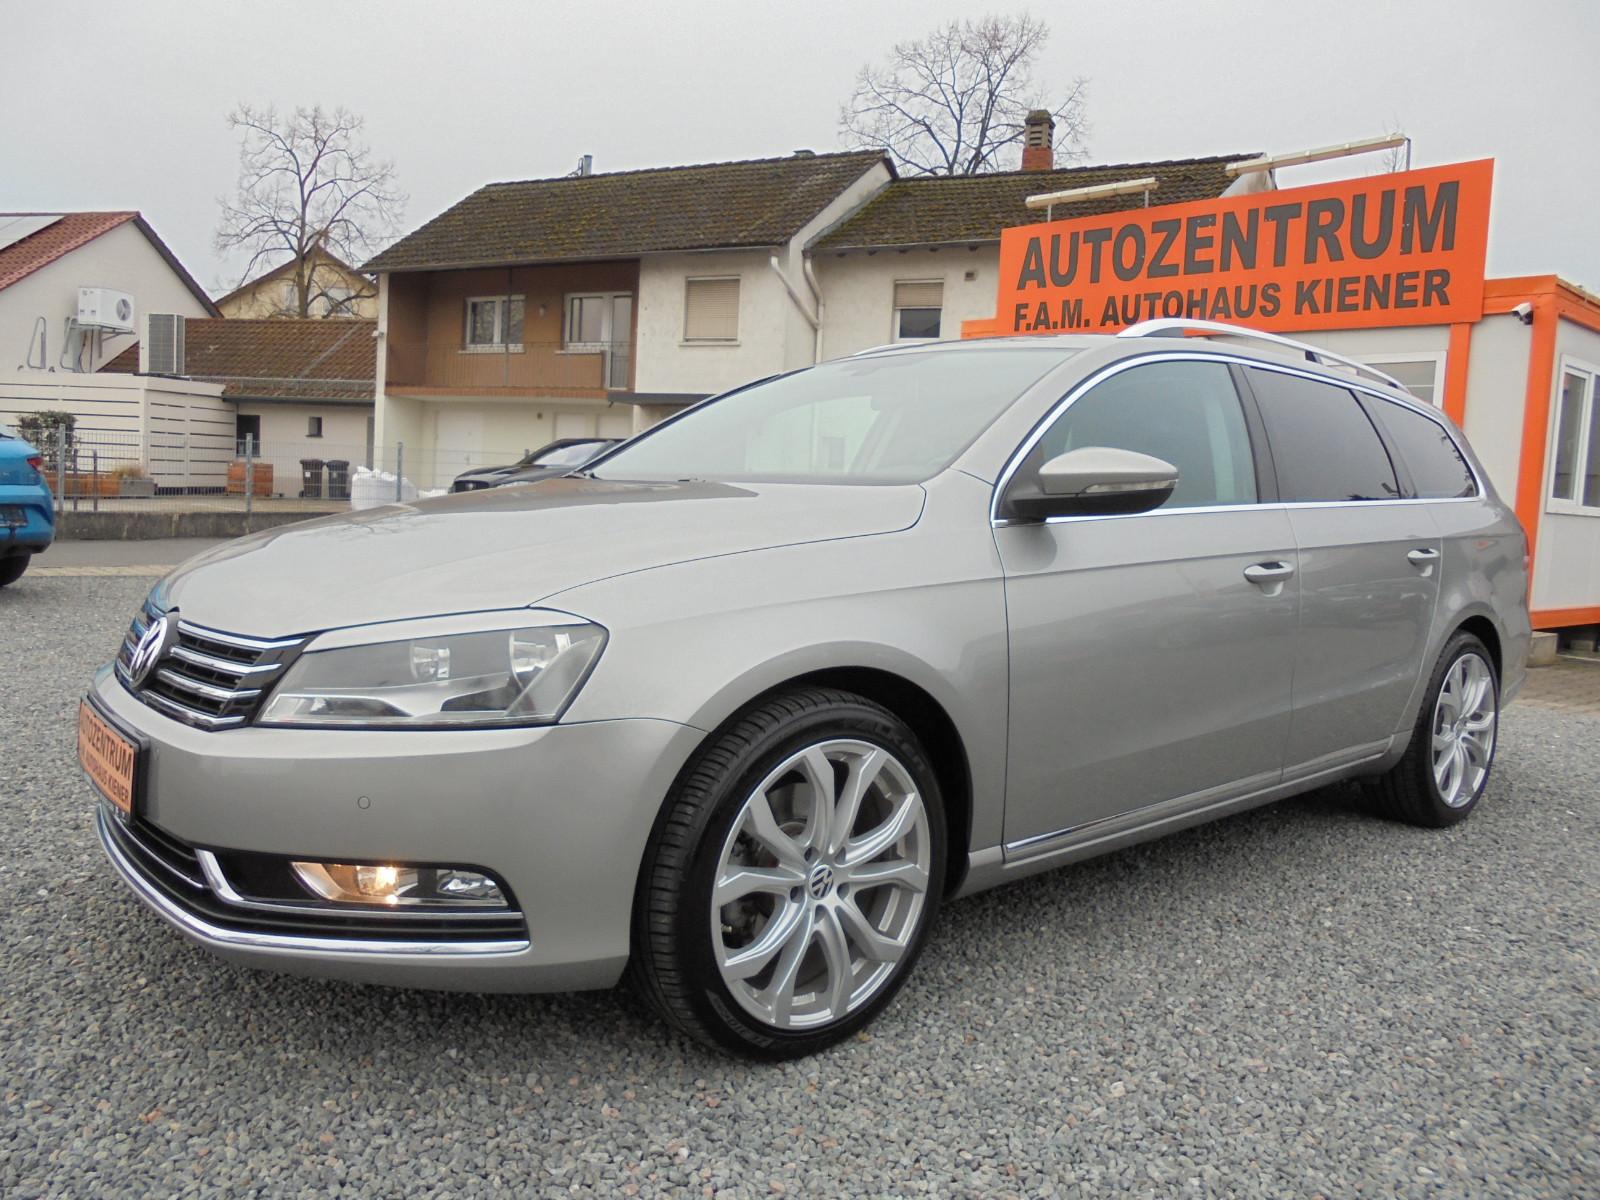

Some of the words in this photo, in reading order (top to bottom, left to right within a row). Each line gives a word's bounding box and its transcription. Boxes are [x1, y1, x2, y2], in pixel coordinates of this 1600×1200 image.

[1016, 181, 1460, 290] AUTOZENTRUM
[1013, 298, 1091, 332] F.A.M.
[1099, 282, 1282, 328] AUTOHAUS
[1294, 267, 1452, 316] KIENER
